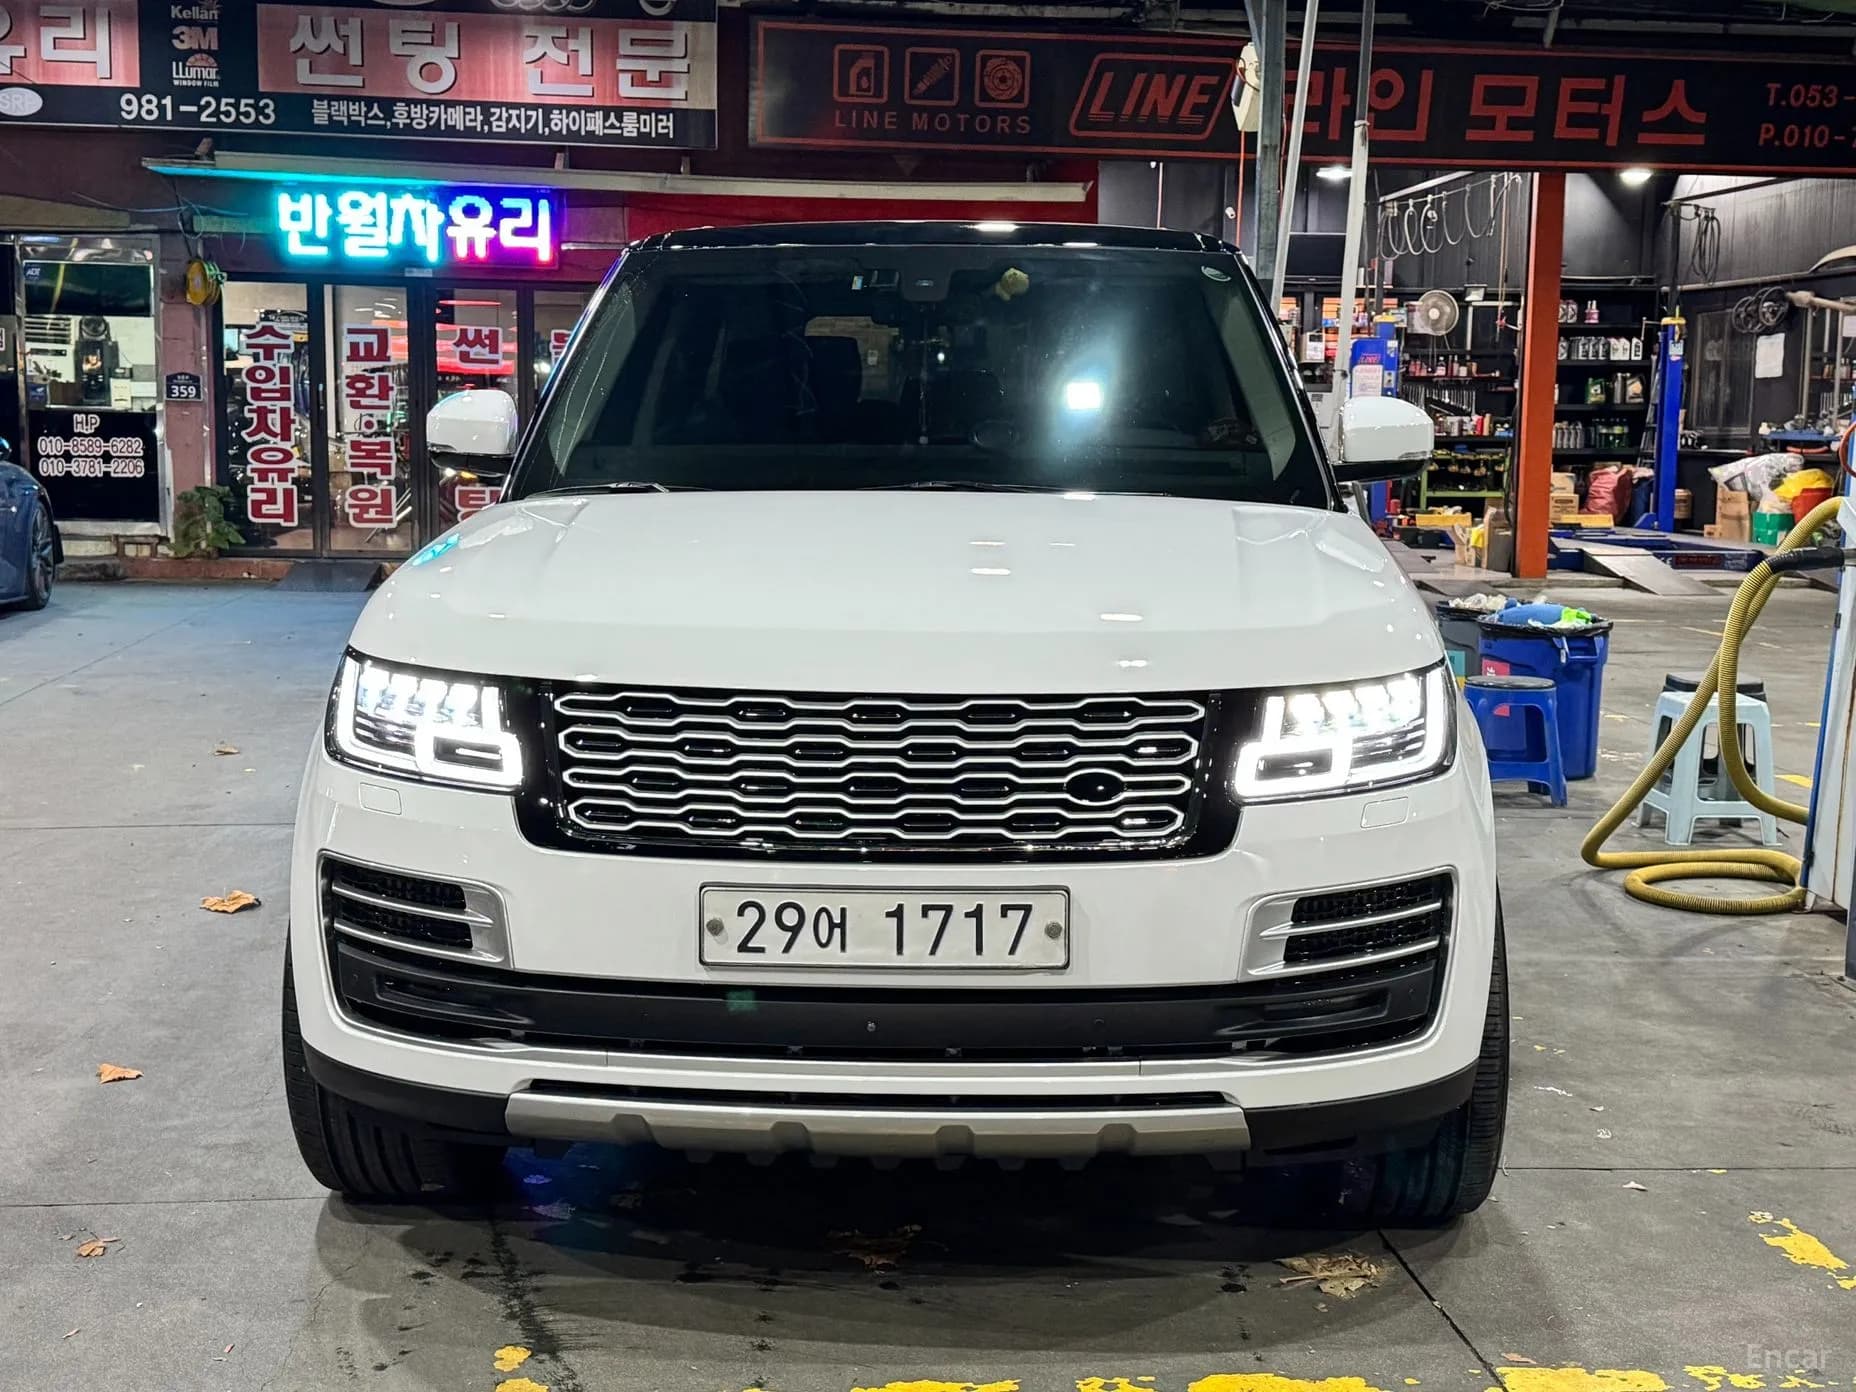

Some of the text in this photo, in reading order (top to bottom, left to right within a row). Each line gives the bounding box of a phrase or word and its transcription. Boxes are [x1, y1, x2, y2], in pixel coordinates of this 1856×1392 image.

[171, 26, 218, 50] 3M
[289, 14, 689, 100] 썬팅 전문
[119, 92, 276, 125] 981-2553
[1088, 71, 1221, 126] LINE
[1284, 67, 1707, 146] 라인 모터스
[834, 108, 1032, 135] LINE MOTORS
[1758, 122, 1856, 148] P.010-
[277, 190, 551, 263] 반월차유리
[170, 385, 197, 398] 359
[243, 322, 300, 526] 수입차유리
[37, 436, 144, 456] 010-8589-6282
[38, 457, 145, 477] 010-3781-2206
[736, 900, 1034, 956] 29어 1717
